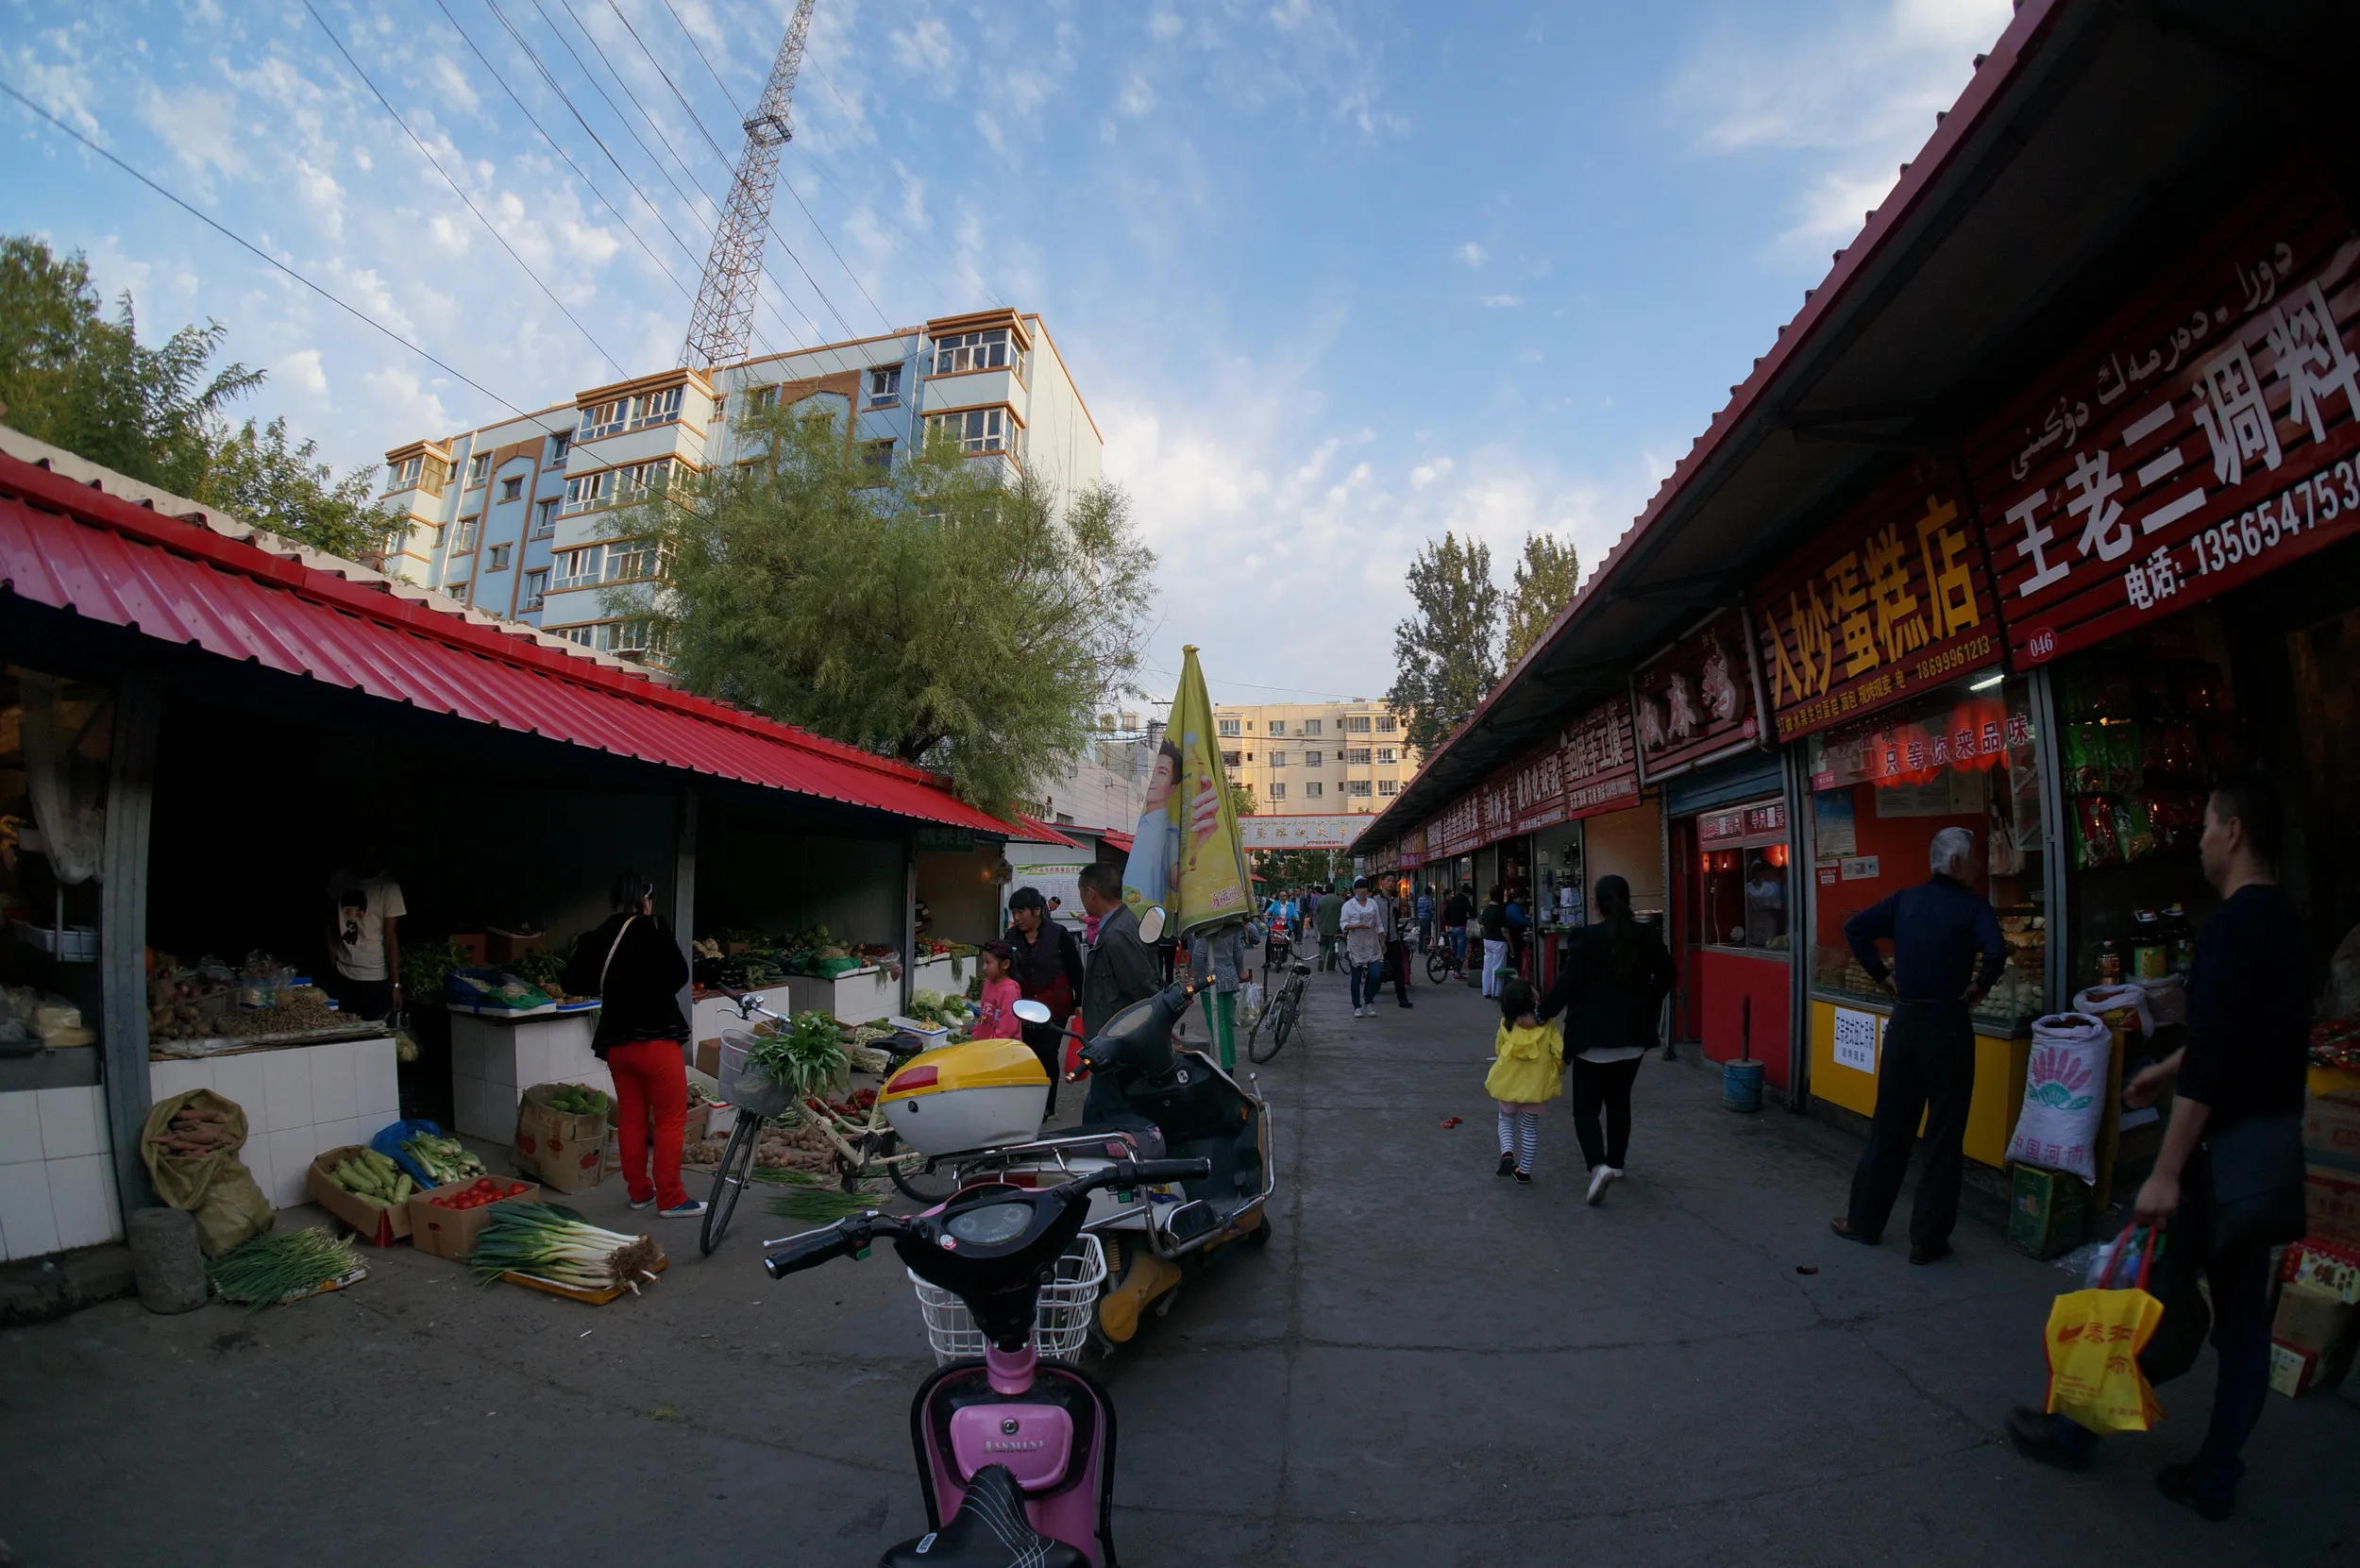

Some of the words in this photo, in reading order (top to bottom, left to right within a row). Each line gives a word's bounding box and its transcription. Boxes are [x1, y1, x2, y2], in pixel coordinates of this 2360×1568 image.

[2004, 280, 2360, 598] 王老三调料
[1766, 493, 1981, 710] 入妙蛋糕店
[1916, 634, 1991, 681] 18699961213
[2030, 632, 2054, 658] 046
[1884, 711, 2029, 775] 只等你来品味
[2013, 1133, 2085, 1166] 中国河南
